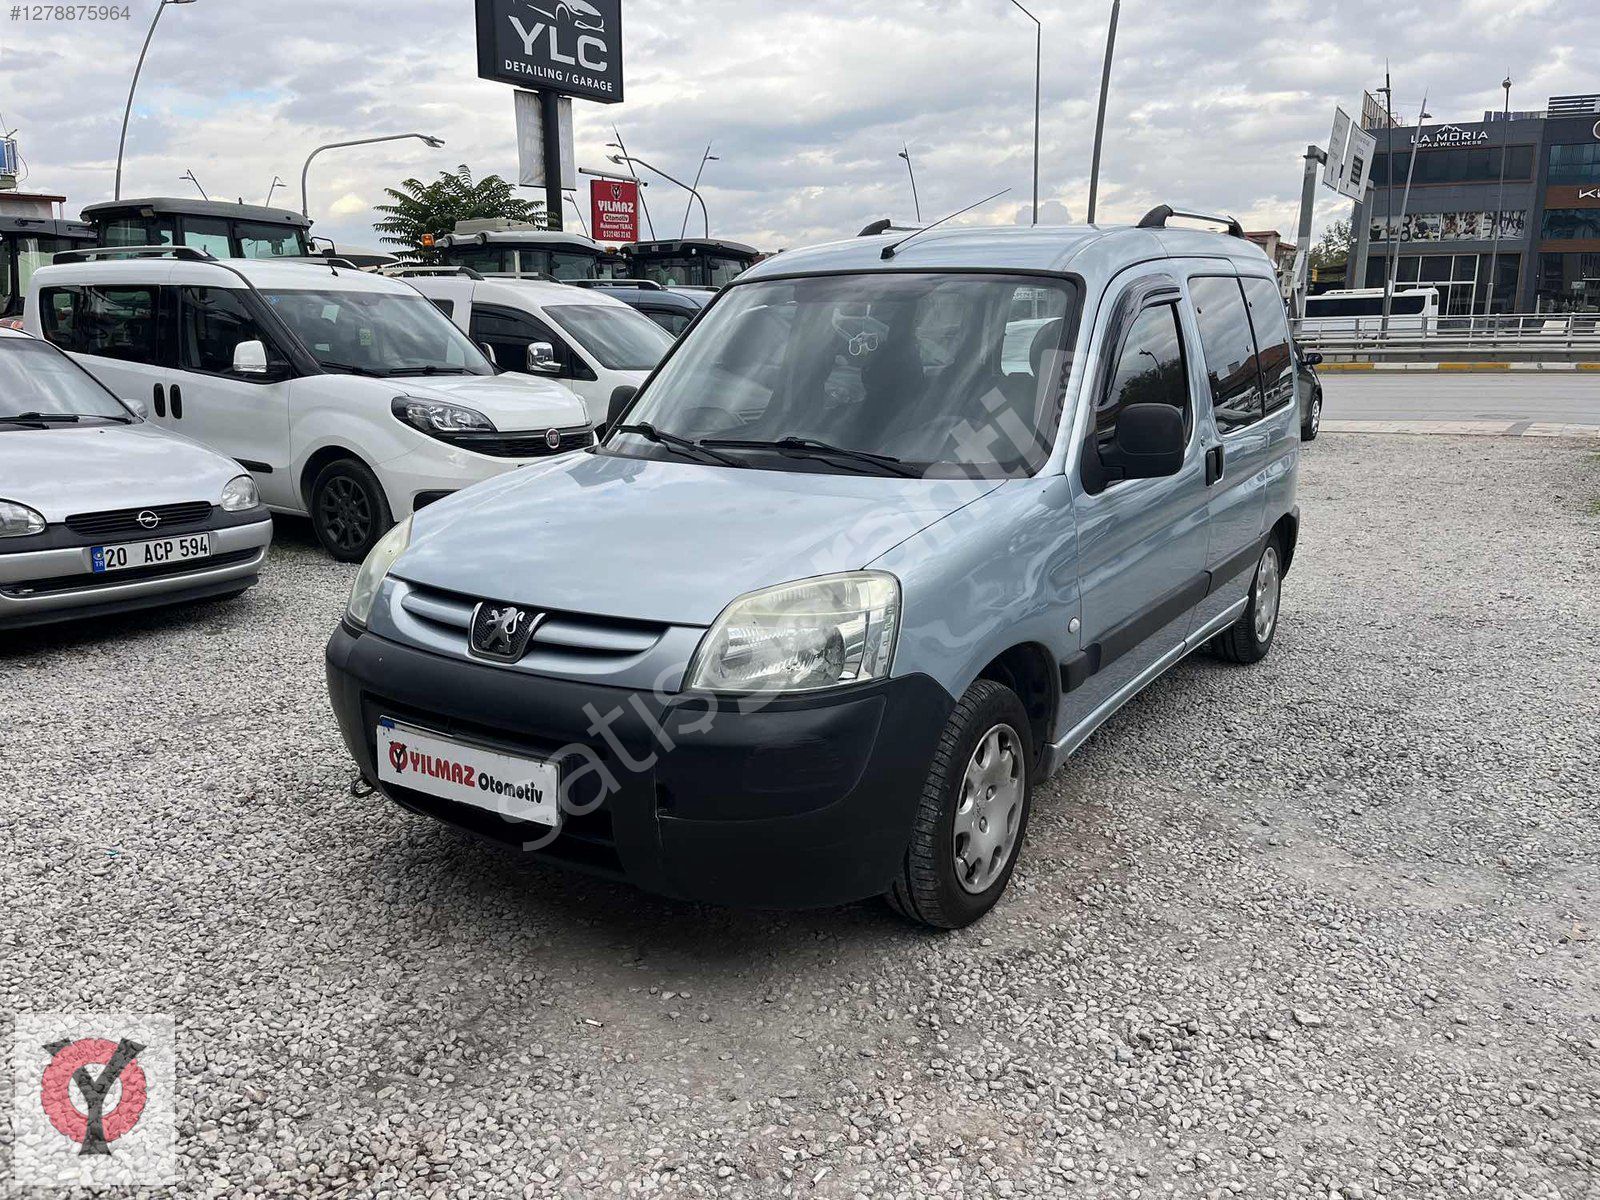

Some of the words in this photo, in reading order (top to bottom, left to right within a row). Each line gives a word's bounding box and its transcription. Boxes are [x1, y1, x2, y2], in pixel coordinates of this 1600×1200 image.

[508, 15, 607, 72] YLC
[505, 59, 563, 81] DETAILING
[572, 74, 613, 92] GARAGE
[1410, 134, 1431, 144] LA
[1436, 131, 1488, 142] MORIA
[598, 200, 634, 213] YILMAZ
[105, 547, 128, 568] 20
[144, 541, 173, 563] ACP
[180, 537, 208, 557] 594
[409, 750, 475, 787] YILMAZ
[478, 772, 543, 804] Otomotiv
